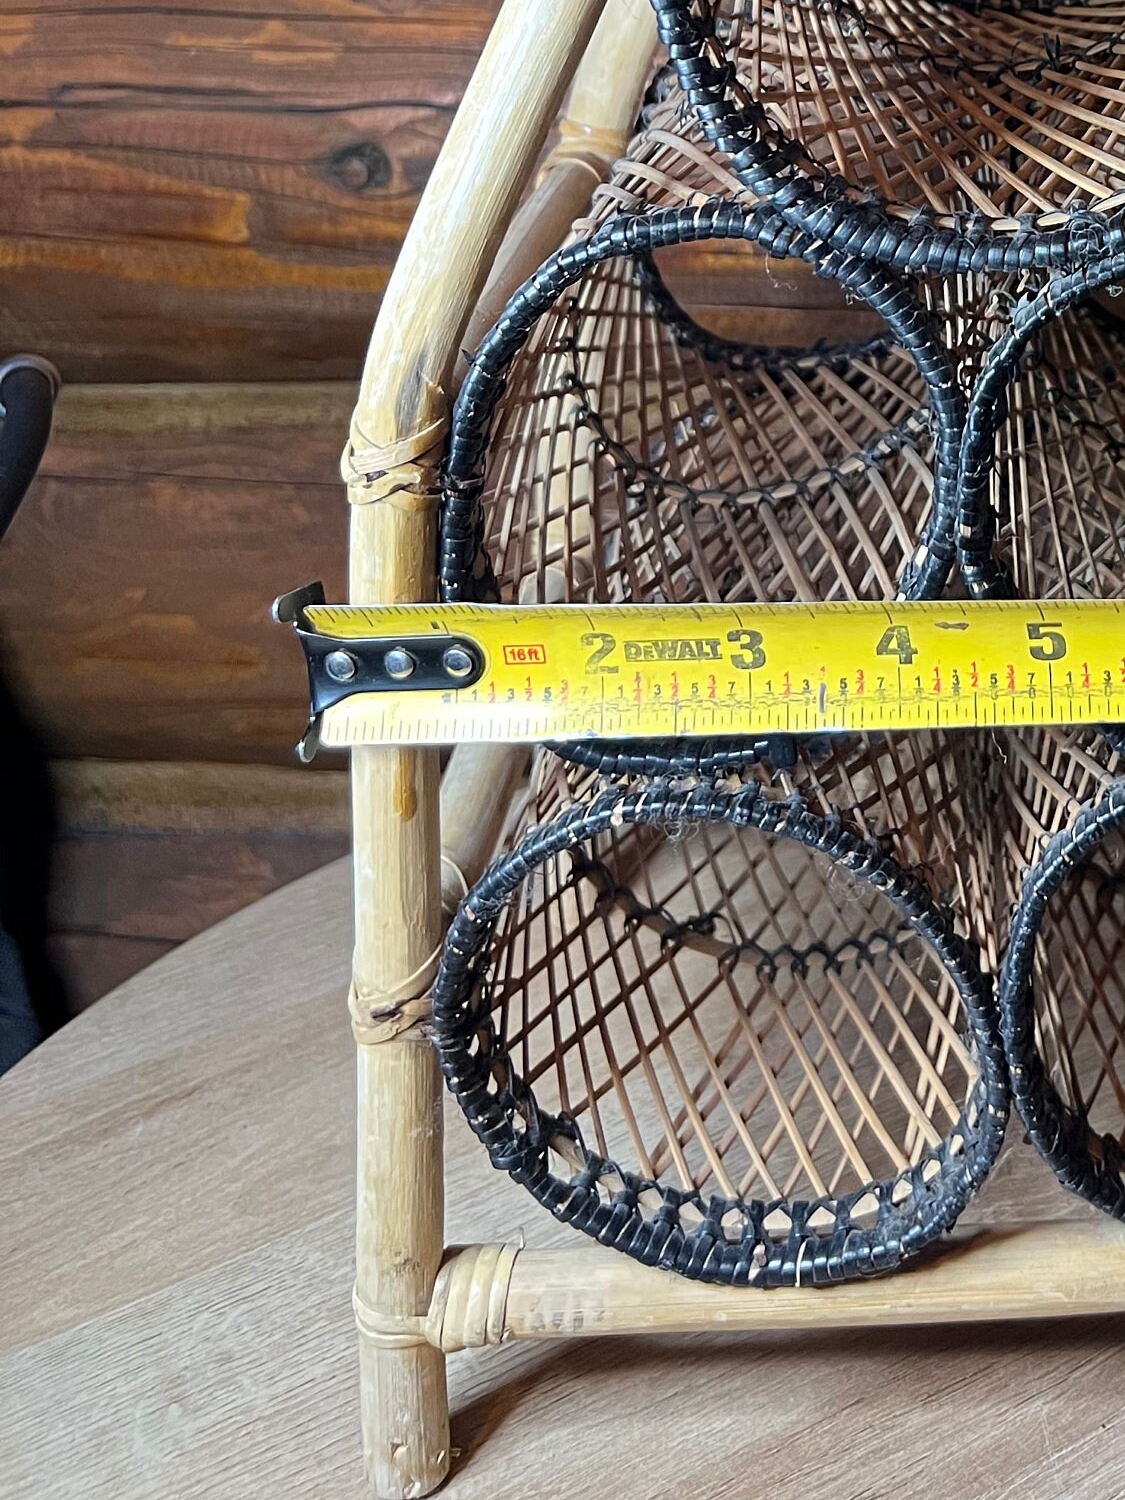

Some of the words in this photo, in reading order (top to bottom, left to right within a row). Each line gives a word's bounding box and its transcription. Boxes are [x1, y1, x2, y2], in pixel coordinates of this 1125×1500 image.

[580, 633, 619, 674] 2
[726, 629, 766, 670] 3
[876, 624, 919, 665] 4
[1026, 622, 1067, 661] 5
